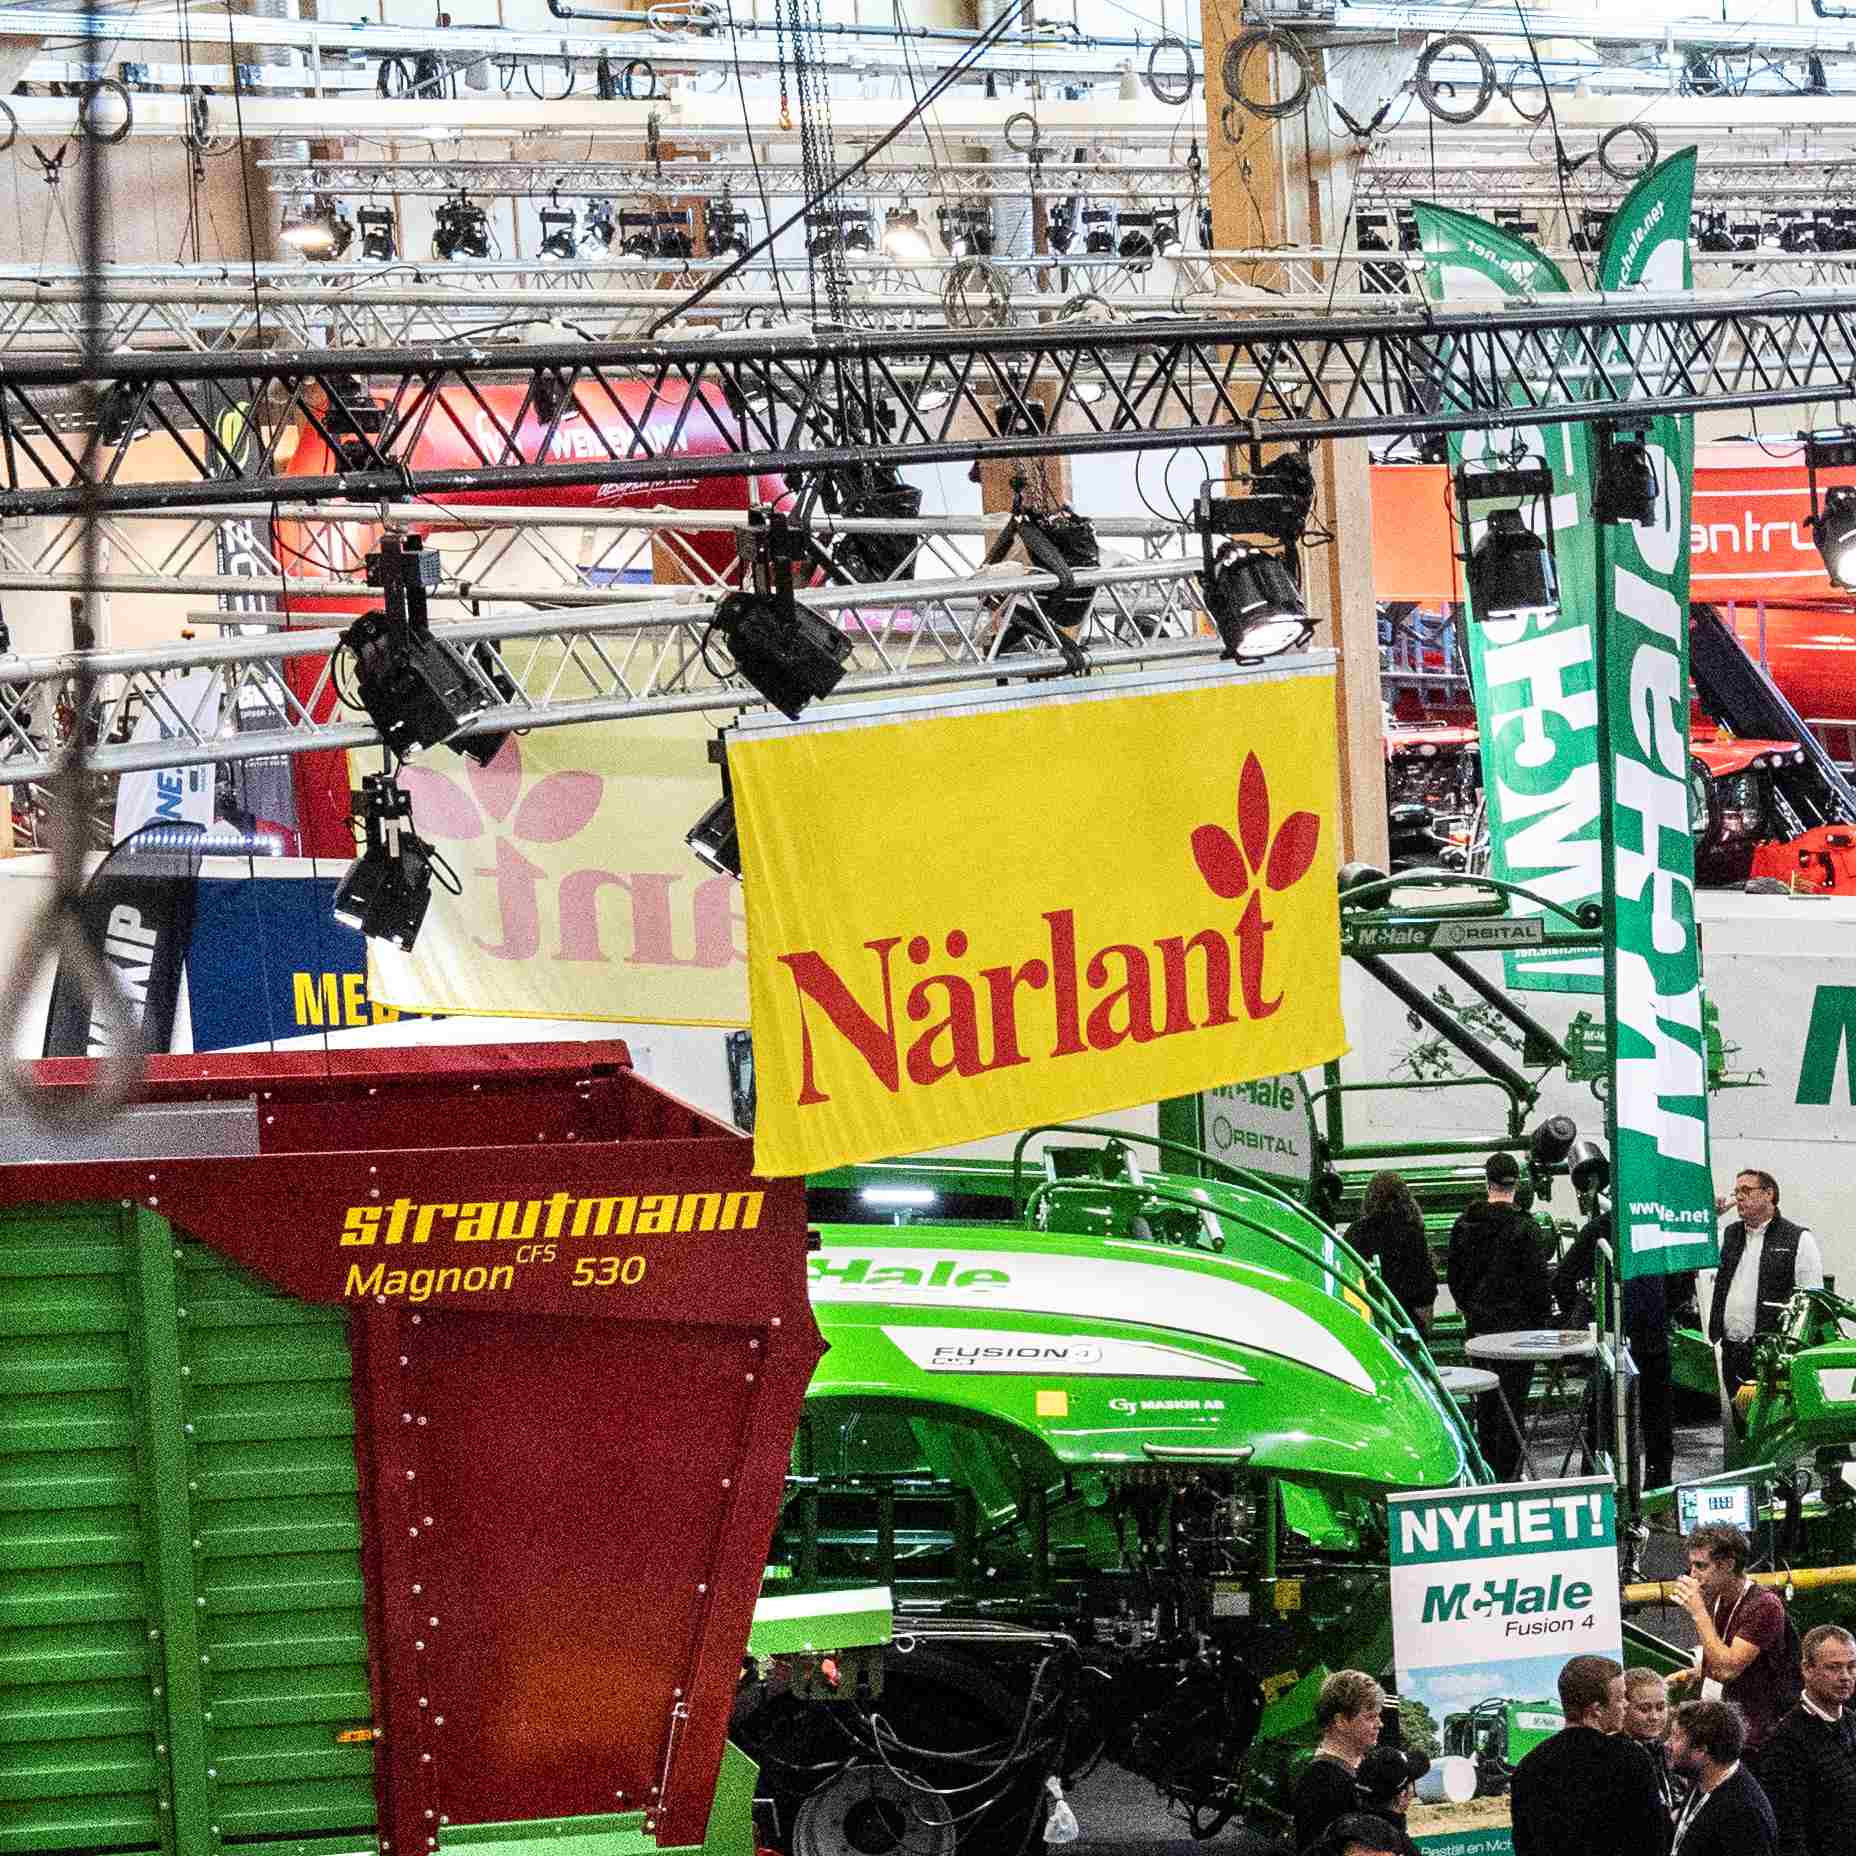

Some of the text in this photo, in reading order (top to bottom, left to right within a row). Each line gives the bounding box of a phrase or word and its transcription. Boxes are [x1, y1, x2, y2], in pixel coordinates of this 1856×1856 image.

[778, 889, 1285, 1106] Närlant
[1213, 1117, 1299, 1156] ORBITAL
[340, 1191, 765, 1247] strautmann
[344, 1244, 647, 1302] Magnon CFS 530
[808, 1258, 1011, 1290] Hale
[934, 1346, 1069, 1359] FUSION
[1401, 1494, 1604, 1555] NYHET!
[1421, 1574, 1594, 1624] McHale
[1504, 1613, 1595, 1641] Fusion 4
